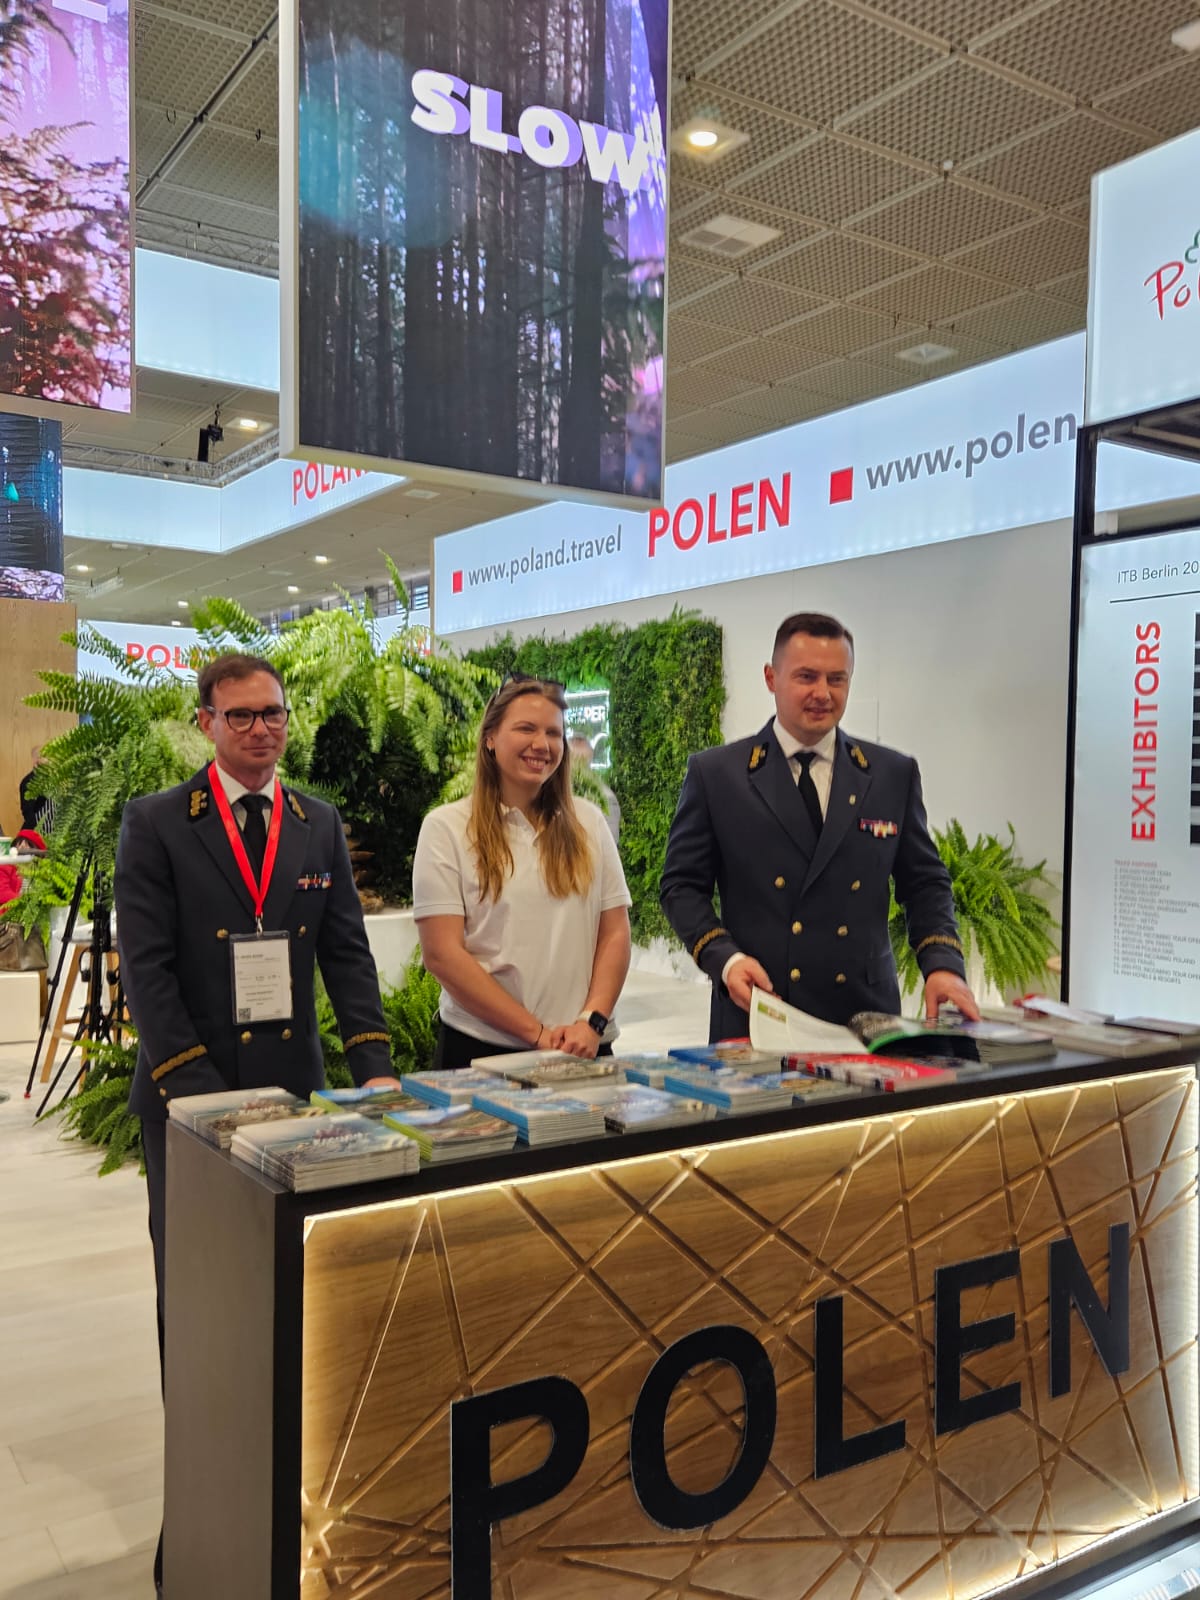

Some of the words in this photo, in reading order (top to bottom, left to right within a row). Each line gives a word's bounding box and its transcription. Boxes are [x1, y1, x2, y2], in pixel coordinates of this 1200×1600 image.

[1144, 260, 1200, 321] Po
[866, 412, 1076, 479] www.polen
[648, 472, 791, 558] POLEN
[468, 524, 622, 584] www.poland.travel
[1117, 569, 1138, 584] ITB
[1142, 564, 1179, 580] Berlin
[1131, 621, 1161, 841] EXHIBITORS
[452, 1223, 1129, 1600] POLEN
